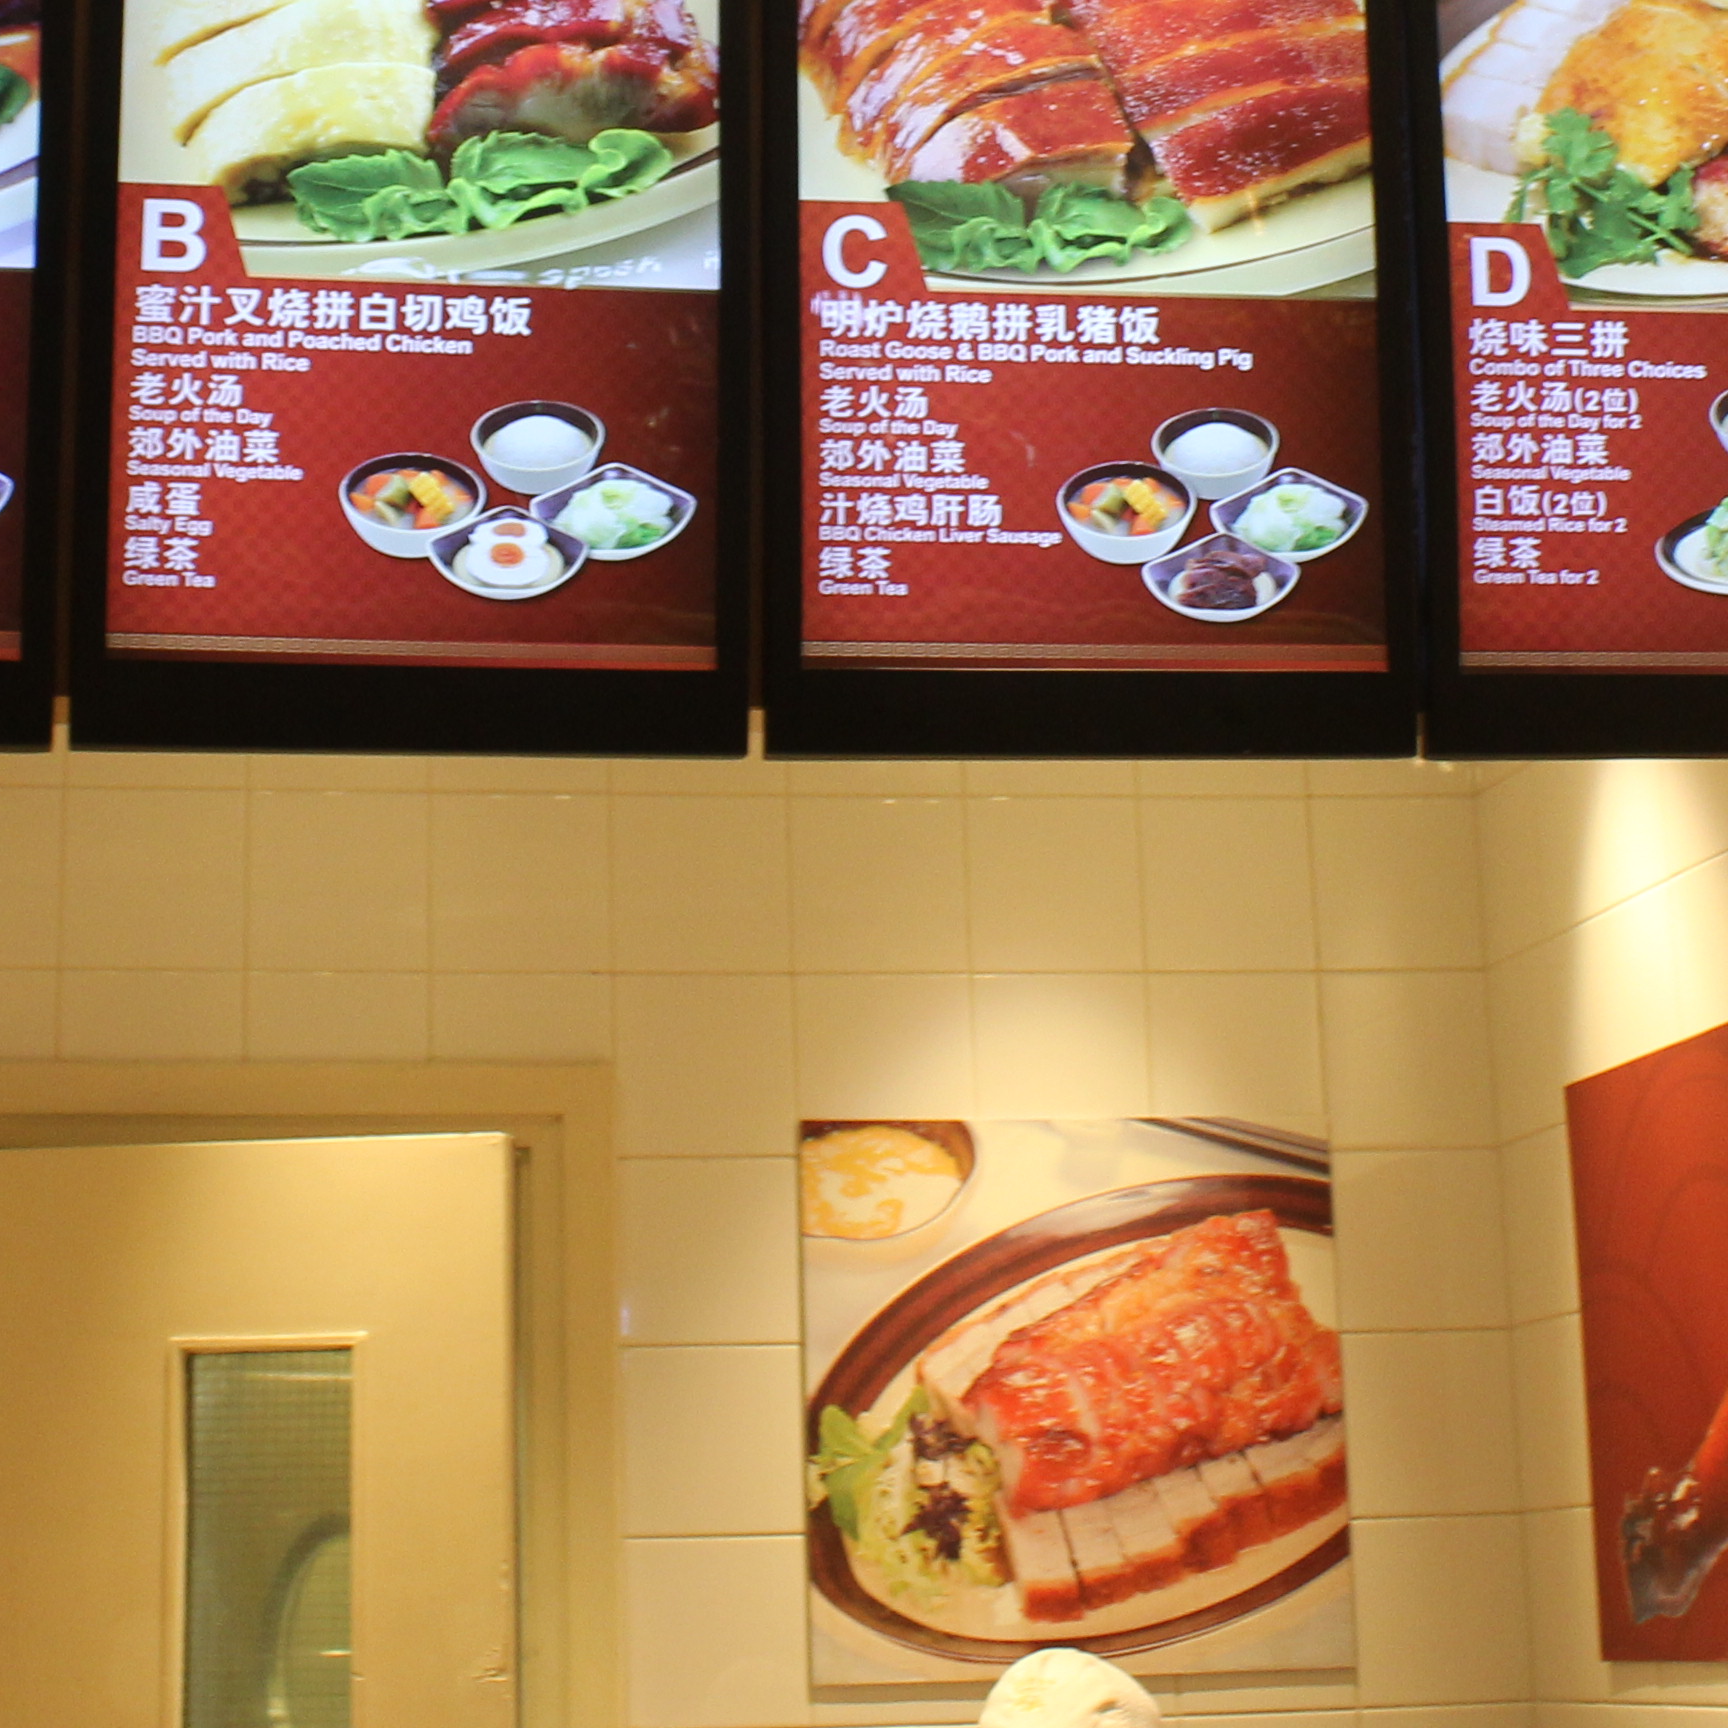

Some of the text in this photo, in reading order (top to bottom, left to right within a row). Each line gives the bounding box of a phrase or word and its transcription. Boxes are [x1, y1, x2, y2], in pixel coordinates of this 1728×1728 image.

[140, 197, 208, 272] B
[821, 213, 889, 289] C
[1470, 236, 1532, 307] D
[134, 284, 533, 336] 蜜汁叉烧拼白切鸡饭
[820, 299, 1161, 344] 明炉烧鹅拼乳猪饭
[132, 325, 473, 355] BBQ Pork and Poached Chicken
[1468, 318, 1630, 358] 烧味三拼
[130, 348, 311, 372] Served with Rice
[819, 339, 1254, 371] Roast Goose & BBQ Pork and Suckling Pig
[1468, 357, 1708, 380] Combo of Three Choices
[130, 372, 244, 407] 老火汤
[819, 363, 993, 384] Served with Rice
[128, 405, 273, 429] Soup of the Day
[820, 384, 929, 419] 老火汤
[818, 418, 959, 439] Soup of the Day
[1470, 413, 1643, 431] Soup of the Day for 2
[128, 426, 281, 463] 郊外油菜
[820, 438, 966, 473] 郊外油菜
[1471, 432, 1609, 465] 郊外油菜
[126, 459, 305, 482] Seasonal Vegetable
[818, 472, 990, 492] Seasonal Vegetable
[1471, 464, 1632, 484] Seasonal Vegetable
[125, 480, 202, 516] 咸蛋
[820, 492, 1003, 527] 汁烧鸡肝肠
[124, 514, 214, 537] Salty Egg
[818, 526, 1063, 548] BBQ Chicken Liver Sausage
[1472, 516, 1628, 534] Steamed Rice for 2
[123, 536, 200, 570] 绿茶
[818, 546, 893, 579] 绿茶
[1473, 536, 1542, 569] 绿茶
[122, 569, 217, 588] Green Tea
[818, 579, 909, 596] Green Tea
[1473, 568, 1600, 586] Green Tea for 2
